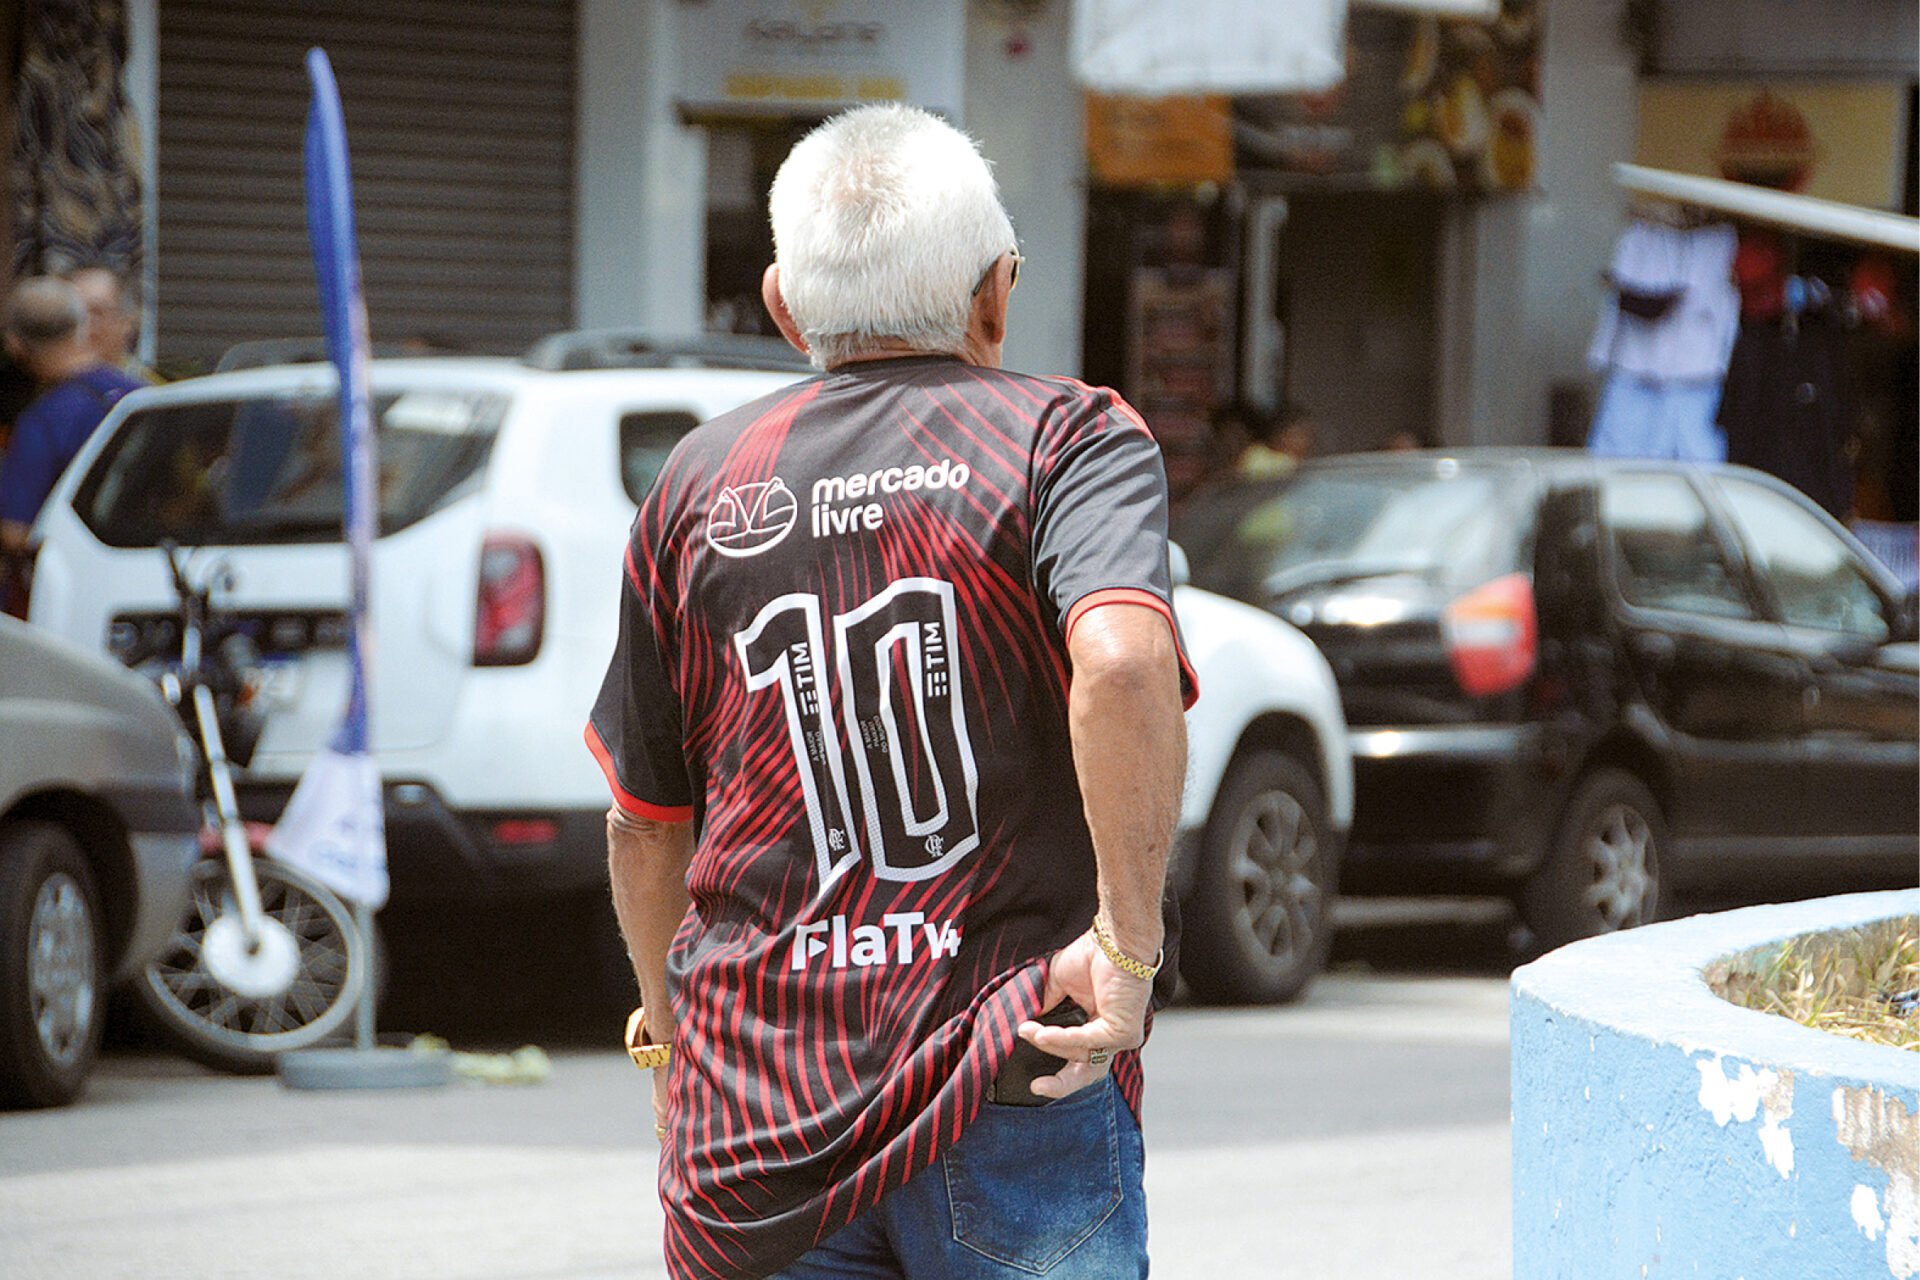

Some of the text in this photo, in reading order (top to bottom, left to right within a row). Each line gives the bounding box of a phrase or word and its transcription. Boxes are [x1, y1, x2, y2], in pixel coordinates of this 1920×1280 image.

[812, 459, 970, 504] mercado
[812, 503, 883, 538] livre
[734, 577, 979, 898] 10
